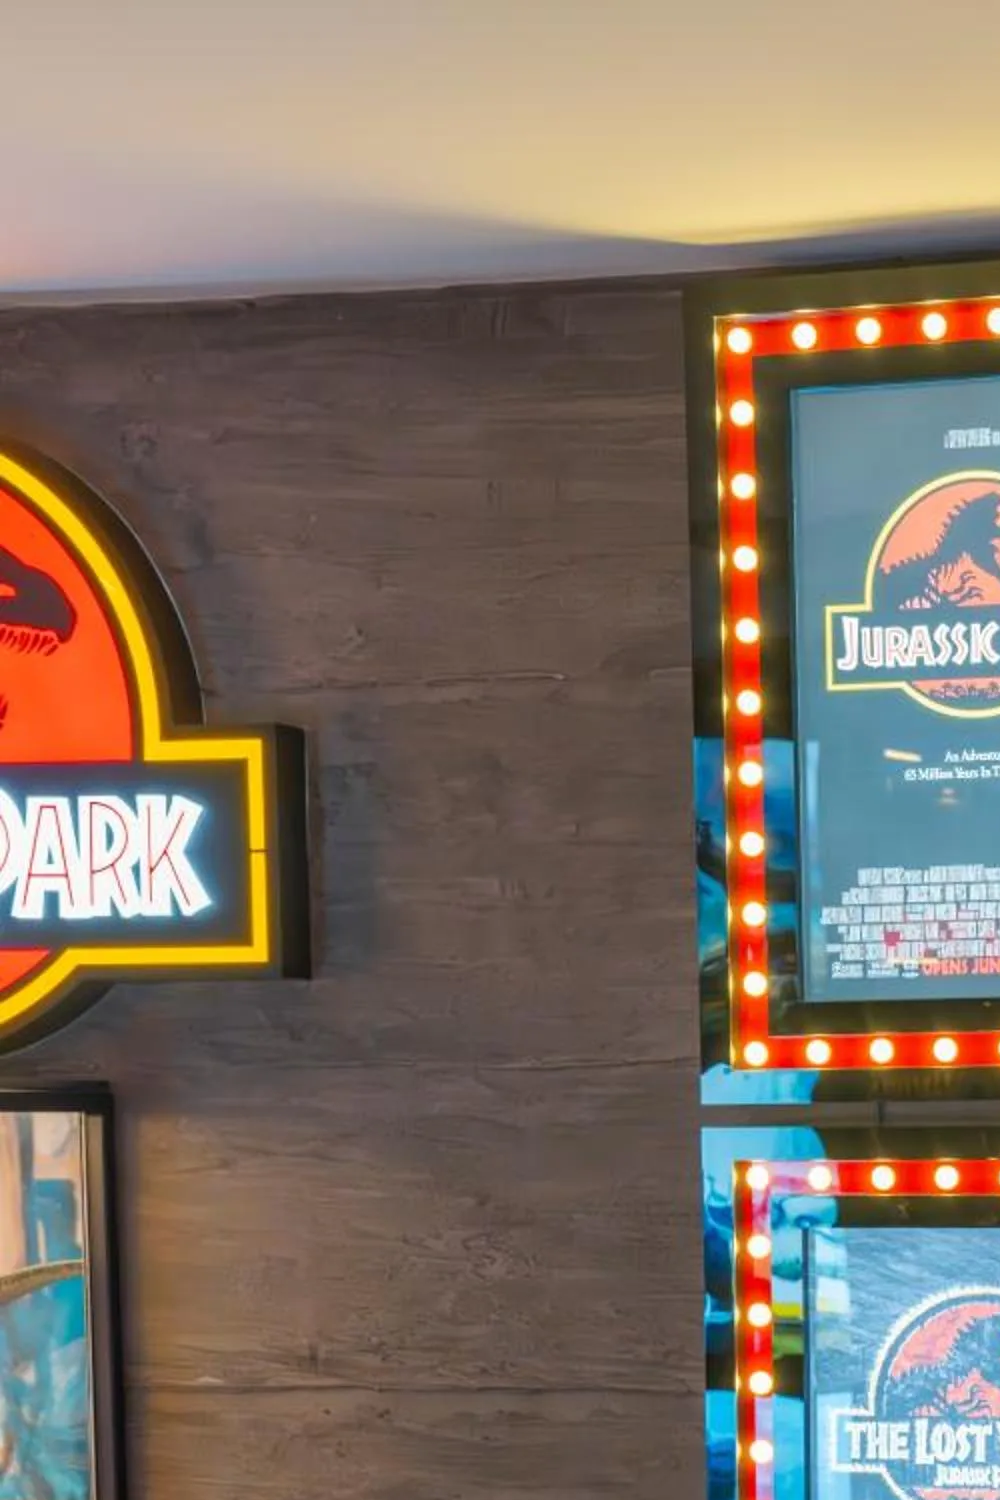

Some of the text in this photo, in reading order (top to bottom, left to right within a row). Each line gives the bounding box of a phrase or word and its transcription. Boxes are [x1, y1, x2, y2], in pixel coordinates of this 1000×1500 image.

[944, 751, 959, 763] An
[918, 767, 954, 780] Million
[954, 767, 979, 779] Years
[980, 766, 991, 778] In
[846, 1418, 910, 1461] THE
[914, 1418, 993, 1466] LOST
